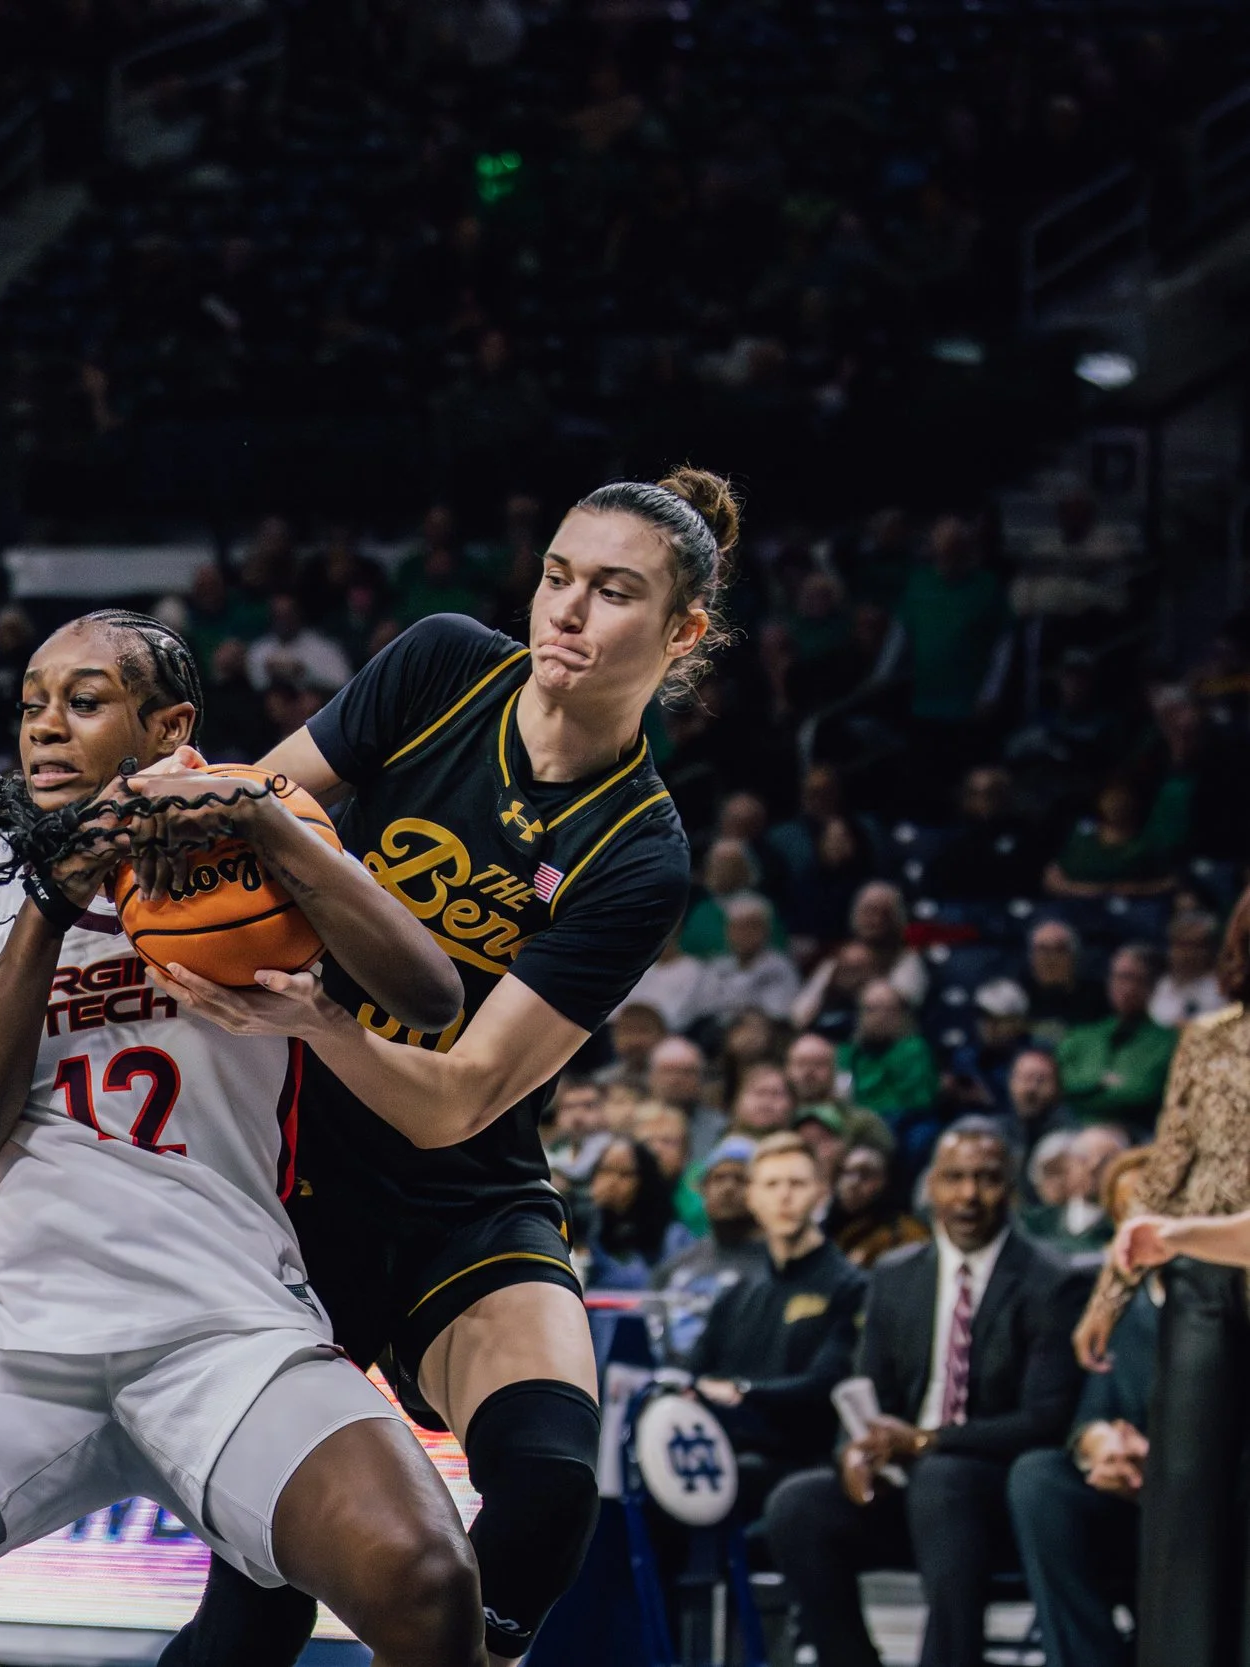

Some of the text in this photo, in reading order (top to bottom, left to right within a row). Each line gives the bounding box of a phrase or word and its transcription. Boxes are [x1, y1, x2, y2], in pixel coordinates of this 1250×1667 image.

[362, 817, 533, 961] Ben
[469, 863, 537, 912] THE
[53, 1046, 188, 1158] 12
